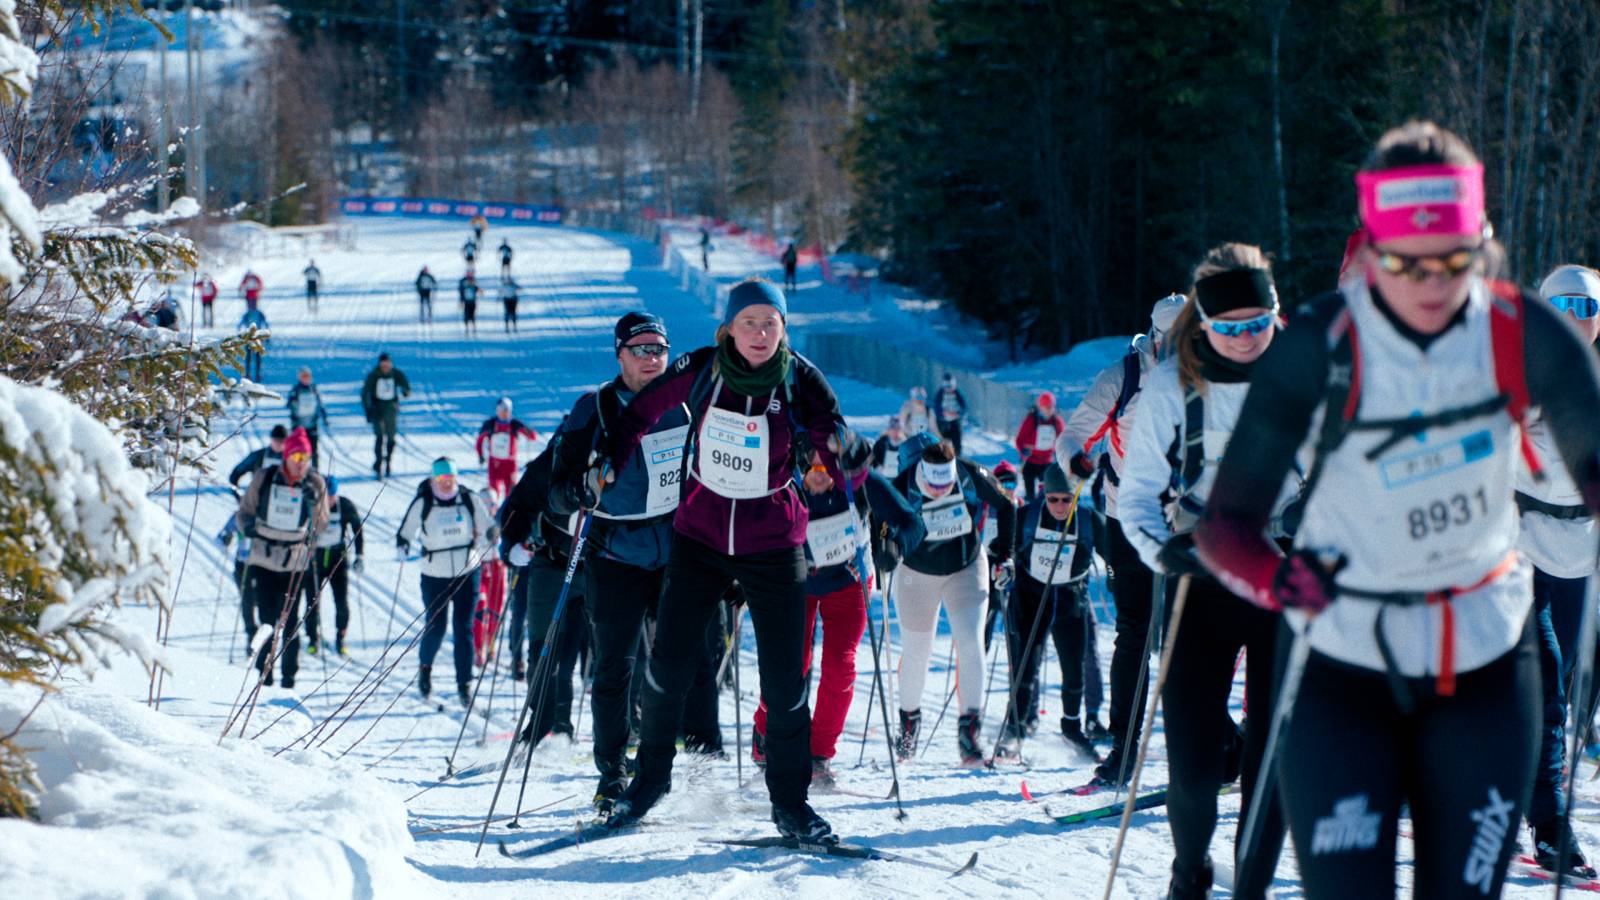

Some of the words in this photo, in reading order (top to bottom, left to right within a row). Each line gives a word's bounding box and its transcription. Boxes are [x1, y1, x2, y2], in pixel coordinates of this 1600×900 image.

[711, 449, 753, 473] 9809
[1407, 487, 1489, 540] 8931
[564, 537, 586, 584] SALOMON
[1038, 555, 1063, 570] 929
